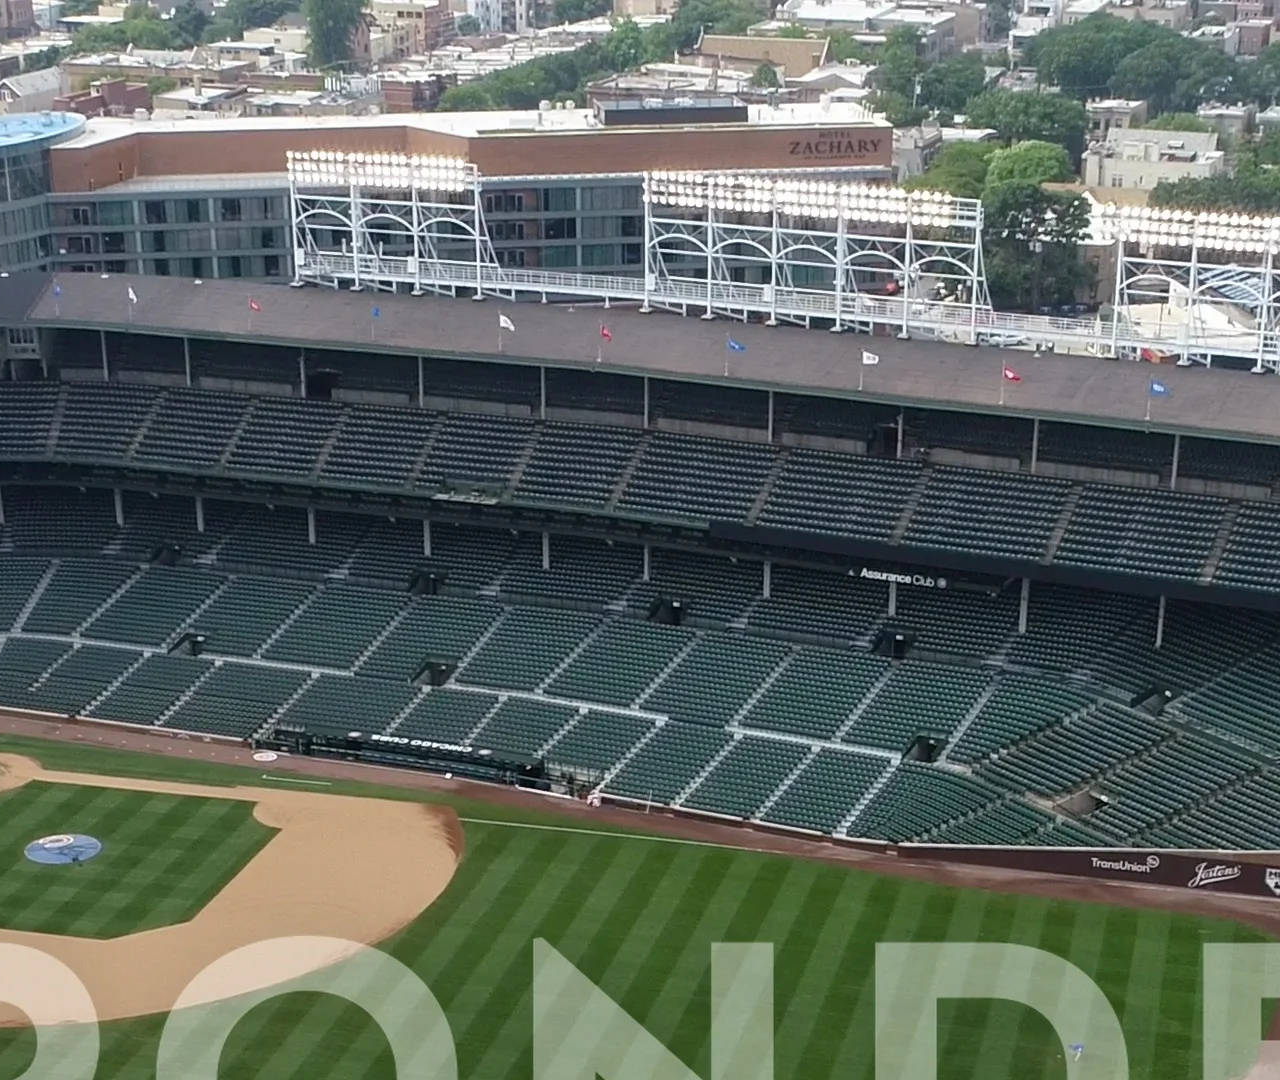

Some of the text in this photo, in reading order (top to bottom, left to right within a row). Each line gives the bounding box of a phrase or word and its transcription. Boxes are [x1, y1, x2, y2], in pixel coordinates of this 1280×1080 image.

[788, 139, 881, 155] ZACHARY
[860, 568, 935, 587] Assurance Club
[370, 734, 473, 753] CHICAGO CUBS
[1091, 857, 1151, 873] TransUnion
